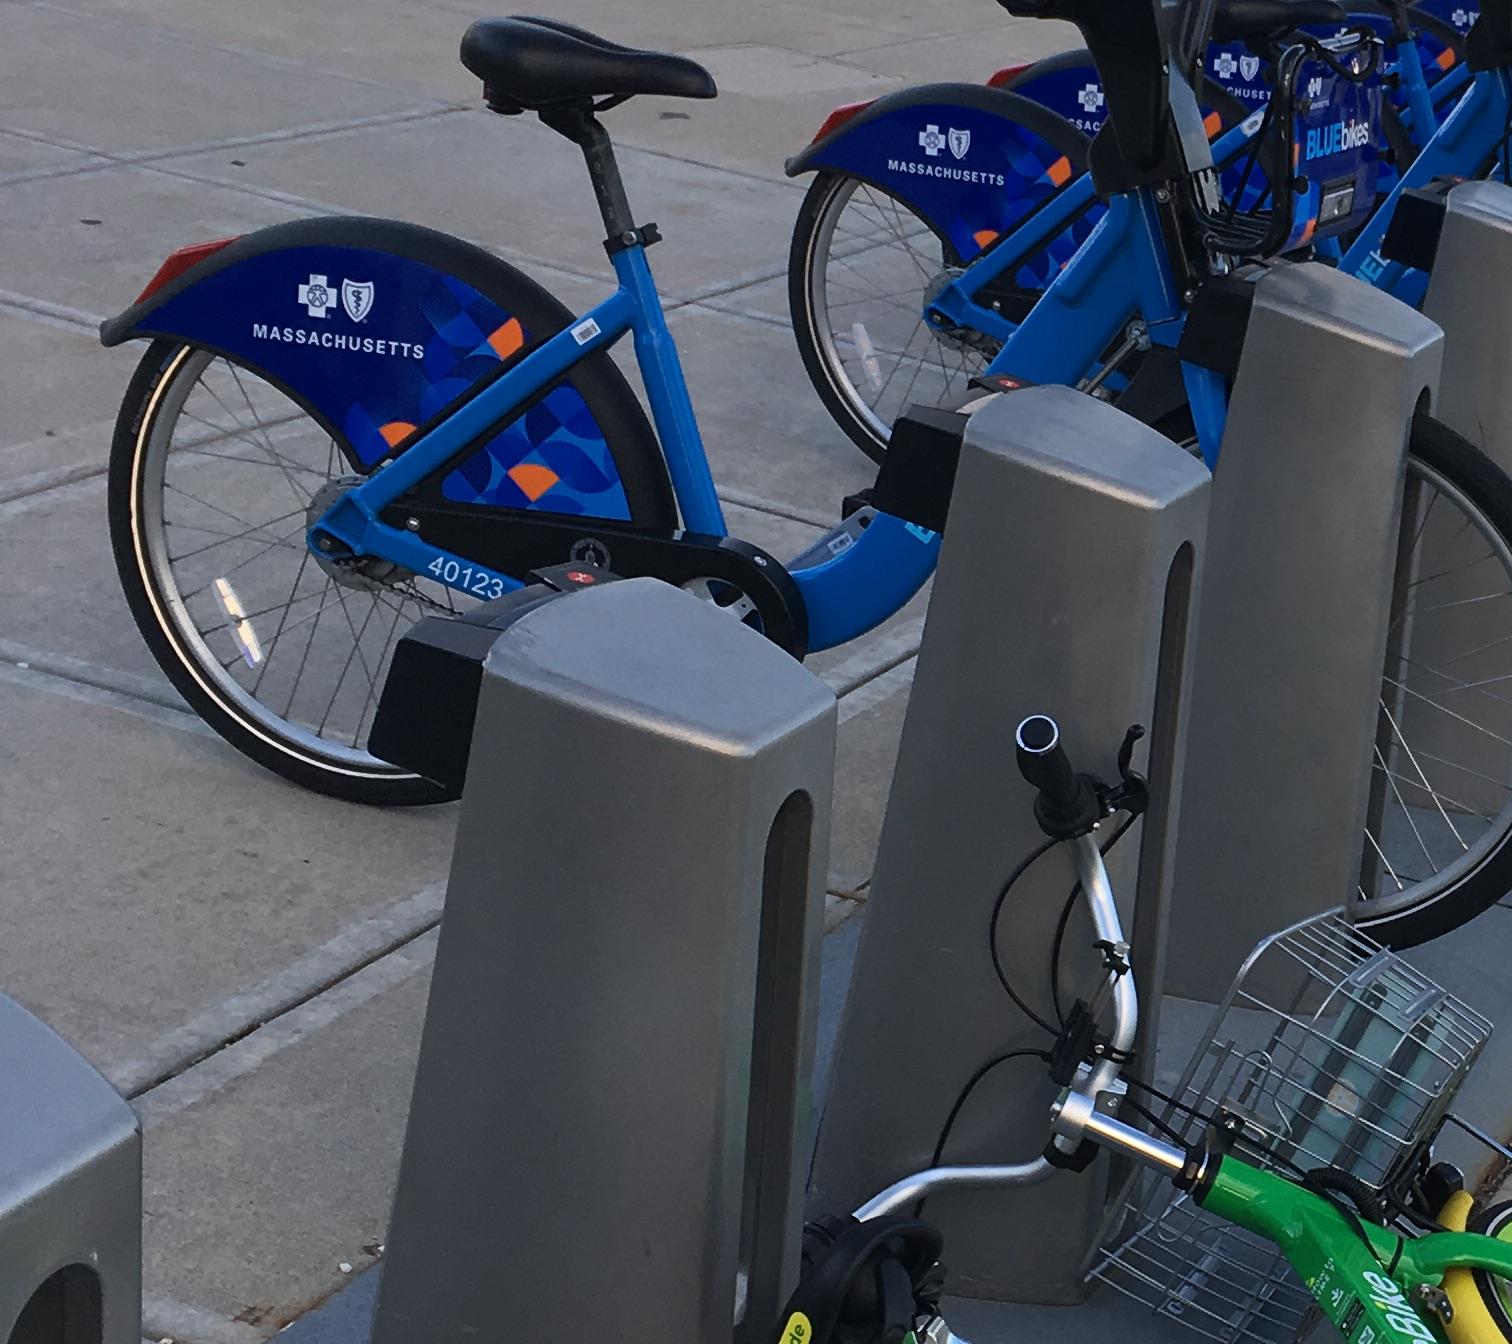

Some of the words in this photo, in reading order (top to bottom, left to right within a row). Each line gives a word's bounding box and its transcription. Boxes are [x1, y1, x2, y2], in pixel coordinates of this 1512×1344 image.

[1306, 118, 1370, 161] BLUEbikes
[888, 159, 1005, 186] MASSACHUSETTS
[252, 323, 425, 360] MASSACHUSETTS
[427, 556, 504, 600] 40123
